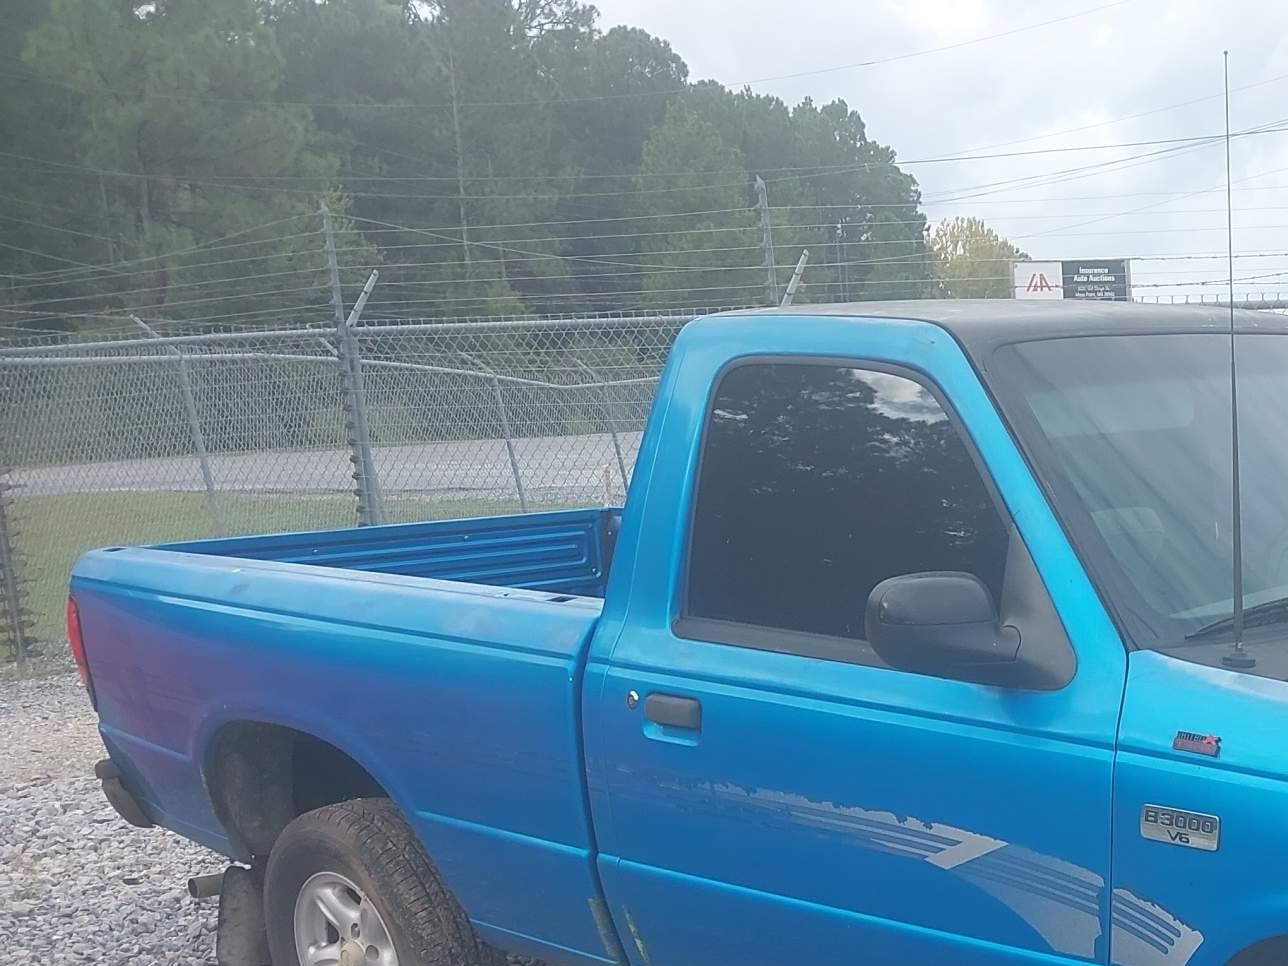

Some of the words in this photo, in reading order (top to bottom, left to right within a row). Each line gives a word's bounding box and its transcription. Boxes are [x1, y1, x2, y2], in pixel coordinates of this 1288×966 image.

[1079, 266, 1109, 274] Insurance
[1145, 811, 1214, 833] B3000
[1167, 829, 1190, 844] V6
